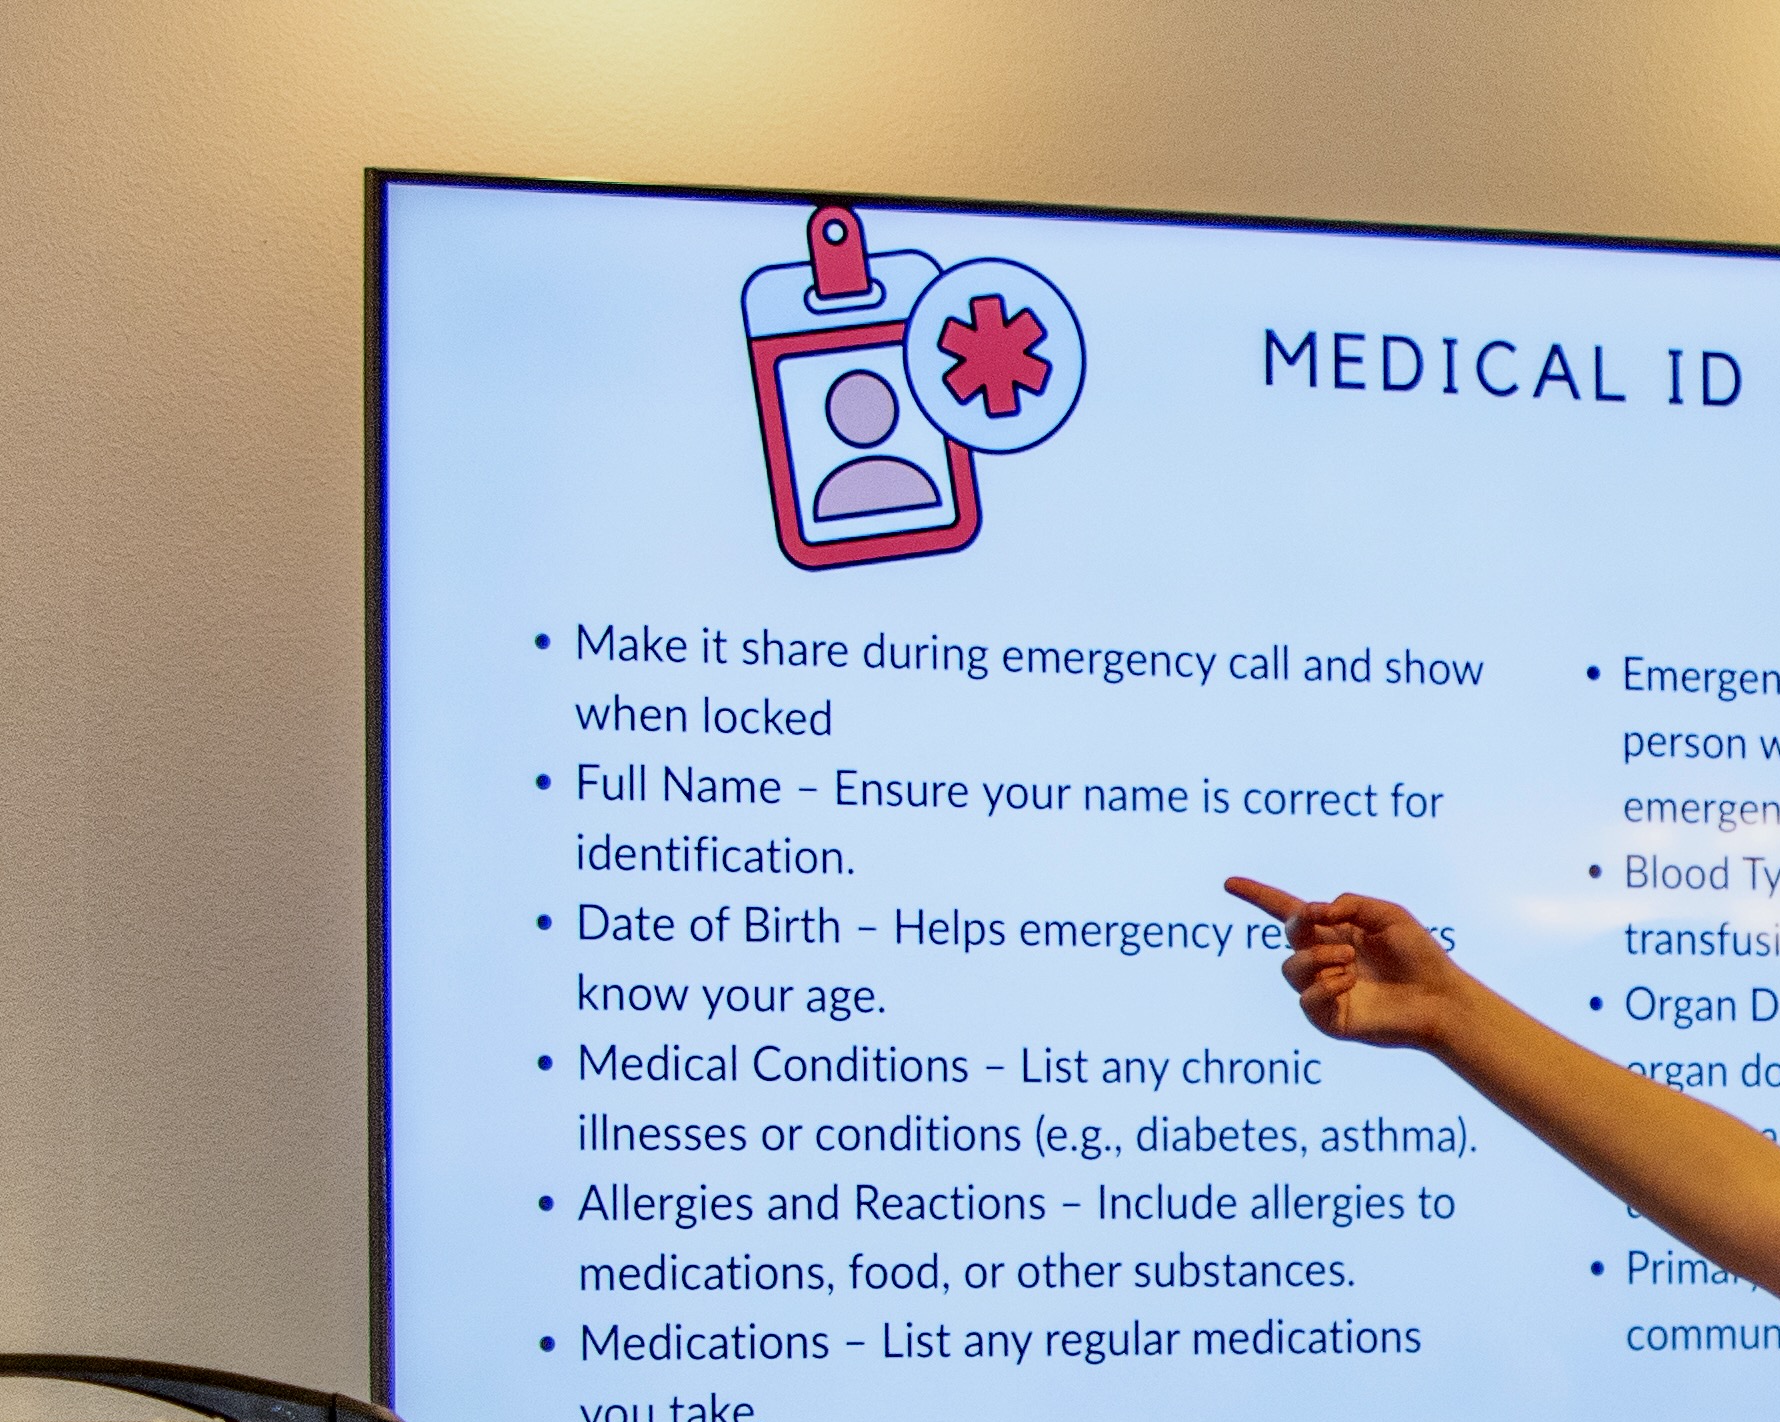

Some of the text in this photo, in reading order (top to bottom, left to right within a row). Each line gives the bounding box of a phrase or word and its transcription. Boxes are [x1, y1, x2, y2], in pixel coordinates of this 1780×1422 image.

[1264, 327, 1742, 407] MEDICAL ID
[577, 623, 1484, 686] Make it share during emergency call and show
[574, 693, 831, 736] when locked
[1624, 731, 1746, 765] person
[578, 763, 645, 801] Full
[664, 765, 781, 804] Name
[836, 769, 969, 808] Ensure
[982, 782, 1071, 817] your
[1084, 785, 1188, 813] name
[1203, 777, 1230, 814] is
[1243, 784, 1378, 817] correct
[1390, 781, 1444, 818] for
[577, 833, 854, 875] identification.
[1626, 854, 1729, 890] Blood
[578, 903, 675, 942] Date
[690, 905, 731, 942] of
[745, 906, 840, 944] Birth
[896, 908, 1006, 954] Helps
[1020, 920, 1233, 957] emergency
[578, 972, 885, 1022] know your age.
[1625, 985, 1736, 1030] Organ
[580, 1043, 737, 1082] Medical
[753, 1044, 968, 1083] Conditions
[1022, 1046, 1088, 1084] List
[1102, 1057, 1170, 1092] any
[1182, 1047, 1322, 1085] chronic
[579, 1113, 1477, 1161] illnesses or conditions (e.g., diabetes, asthma).
[577, 1183, 753, 1230] Allergies
[767, 1183, 838, 1221] and
[856, 1183, 1046, 1221] Reactions
[1099, 1183, 1237, 1220] Include
[1250, 1183, 1405, 1228] allergies
[1418, 1186, 1455, 1220] to
[580, 1251, 1355, 1296] medications, food, or other substances.
[582, 1322, 829, 1361] Medications
[884, 1321, 951, 1358] List
[964, 1331, 1033, 1366] any
[1046, 1319, 1181, 1365] regular
[1193, 1318, 1421, 1355] medications
